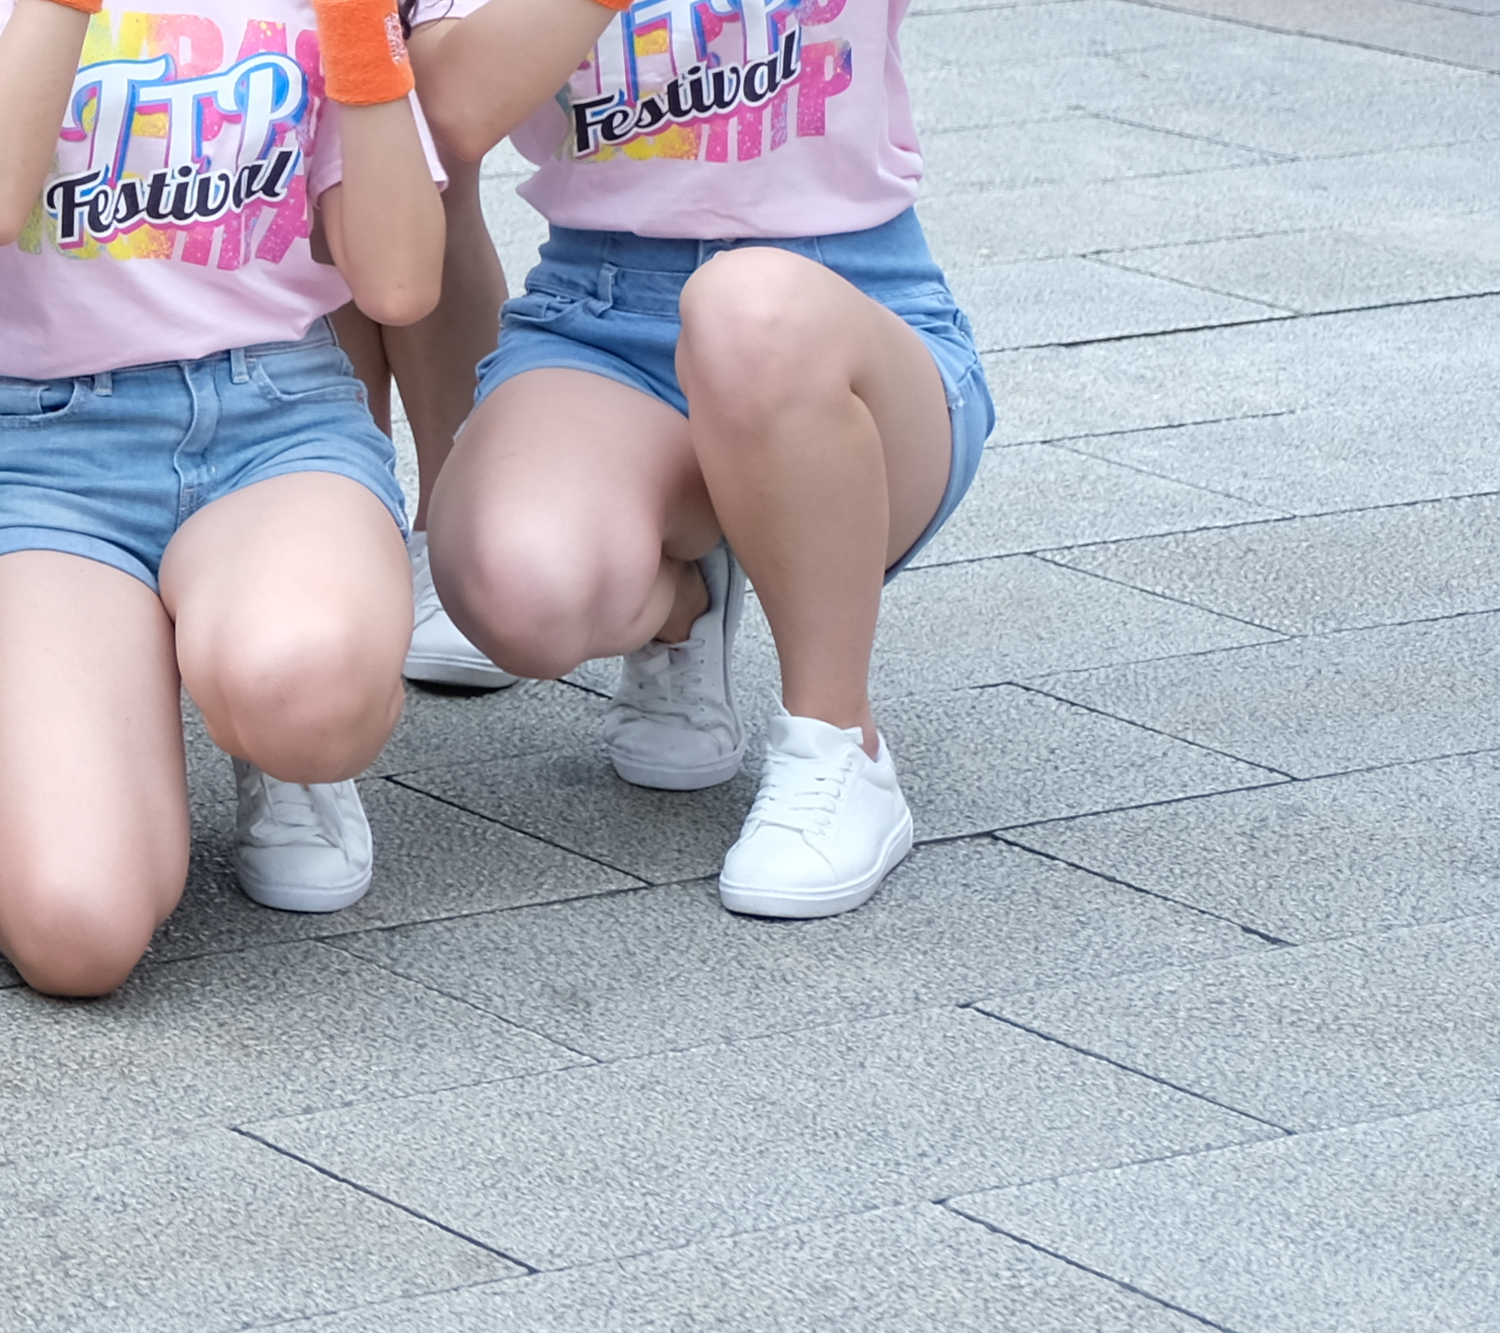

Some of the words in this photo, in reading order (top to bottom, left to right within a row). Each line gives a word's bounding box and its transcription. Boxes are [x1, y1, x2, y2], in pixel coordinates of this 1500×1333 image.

[62, 50, 308, 179] TTP
[573, 29, 796, 153] Festival
[47, 151, 293, 240] Festival
